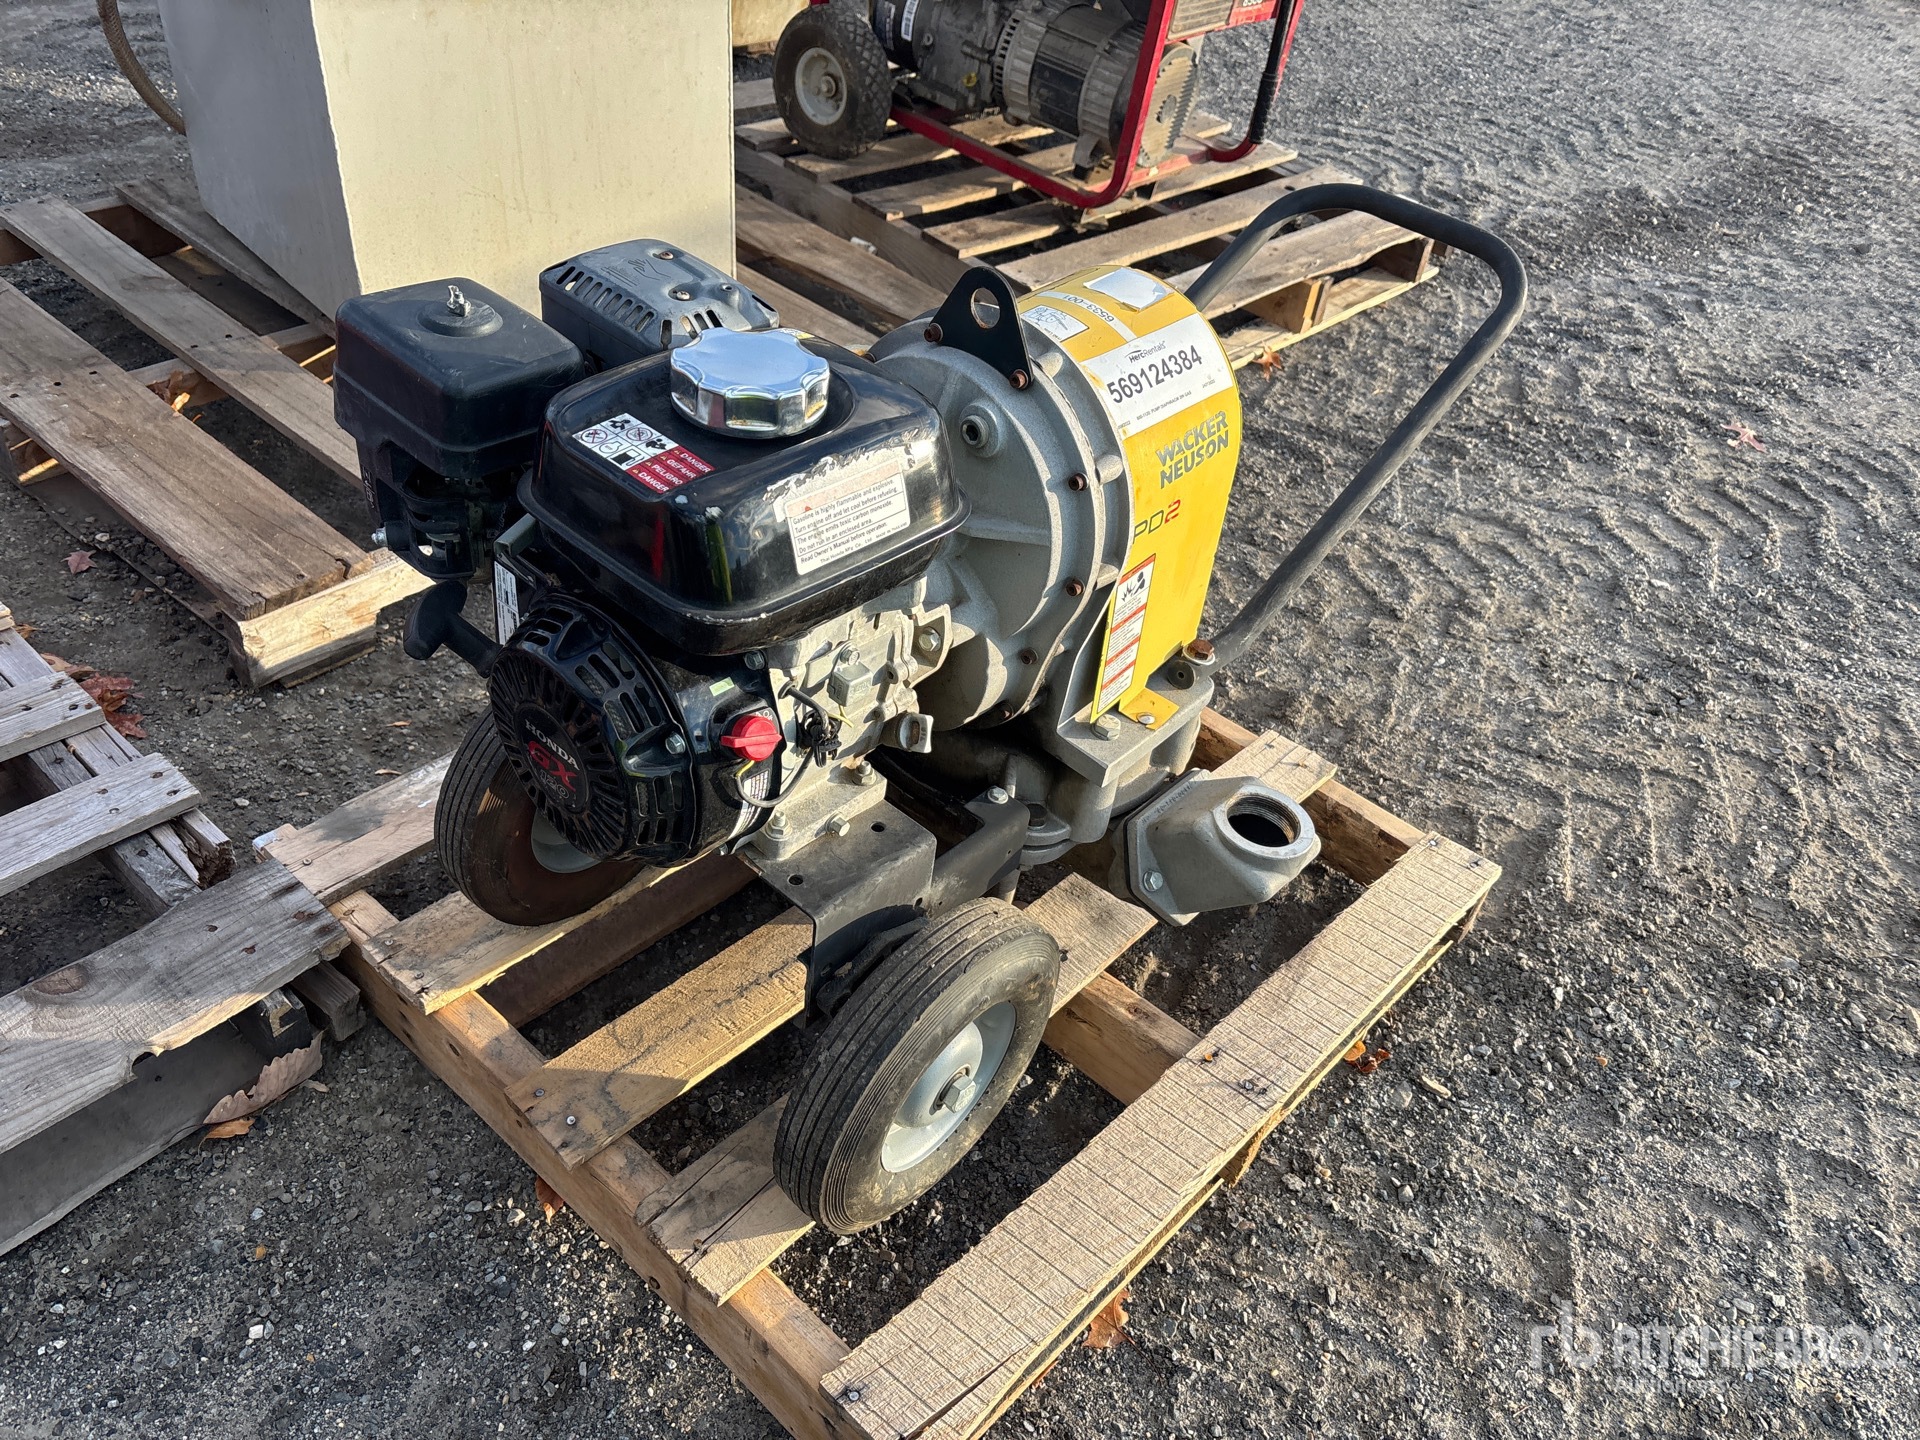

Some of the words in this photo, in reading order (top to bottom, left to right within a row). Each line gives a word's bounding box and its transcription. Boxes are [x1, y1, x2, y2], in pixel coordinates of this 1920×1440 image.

[1106, 344, 1202, 403] 569124384
[1156, 410, 1228, 467] WACKER
[652, 464, 682, 485] PELIGRO
[667, 459, 696, 478] GEFAHR
[681, 453, 711, 472] DANGER
[1160, 430, 1229, 489] NEUSON
[638, 472, 669, 492] DANGER
[793, 512, 814, 525] Gasoline
[820, 501, 835, 513] highly
[836, 492, 862, 507] flammable
[863, 488, 872, 496] and
[807, 518, 824, 529] engine
[833, 510, 842, 518] and
[850, 502, 861, 510] cool
[861, 496, 876, 506] before
[1133, 500, 1180, 544] PD2
[808, 529, 824, 540] engine
[825, 524, 839, 533] emits
[839, 518, 851, 526] toxic
[852, 510, 869, 520] carbon
[839, 522, 860, 536] enclosed
[801, 554, 813, 563] Read
[833, 538, 850, 549] Manual
[850, 532, 865, 542] before
[525, 720, 580, 770] HONDA
[528, 741, 577, 792] GX
